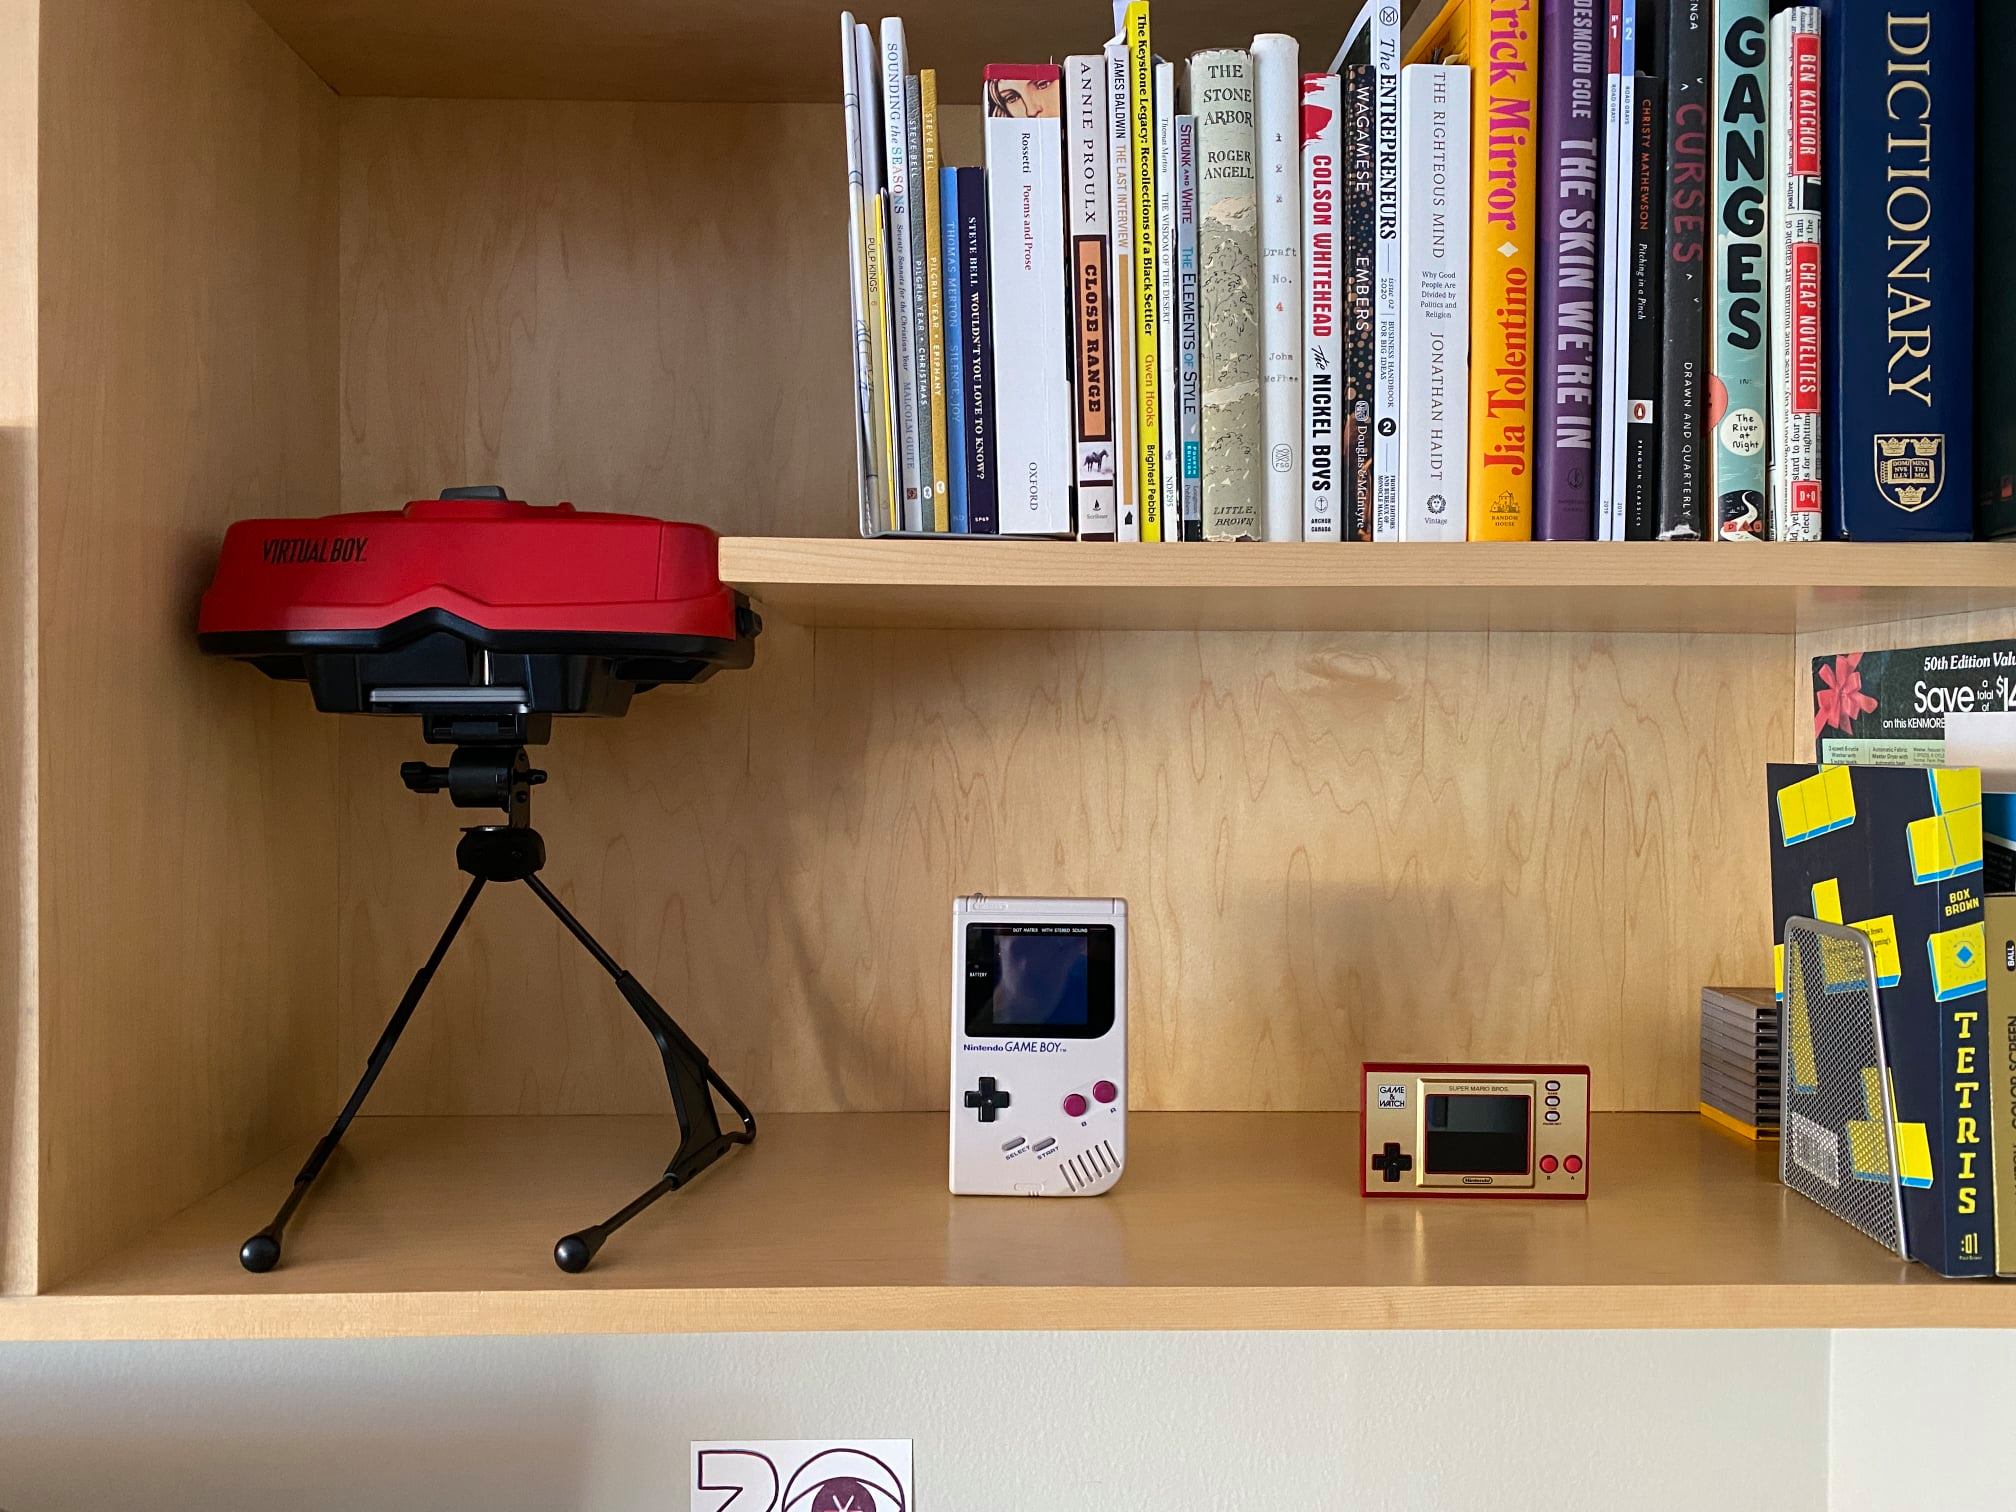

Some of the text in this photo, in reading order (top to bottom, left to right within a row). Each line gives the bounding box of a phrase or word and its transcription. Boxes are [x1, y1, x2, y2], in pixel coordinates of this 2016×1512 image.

[1208, 65, 1243, 79] THE
[1572, 0, 1592, 119] DESMOND COLE
[1800, 54, 1818, 81] BEN
[1113, 58, 1126, 139] JAMES BALDWIN
[1204, 88, 1252, 103] STONE
[1205, 111, 1254, 128] ARBOR
[1799, 90, 1817, 155] KATCHOR
[887, 43, 905, 214] SOUNDING the SEASONS
[909, 120, 918, 178] STEVE BELL
[925, 113, 934, 171] STEVE BELL
[1022, 133, 1032, 173] Rossetti
[1081, 62, 1096, 224] ANNIE PROULX
[1161, 118, 1170, 173] Thomas Merton
[1208, 150, 1252, 164] ROGER
[1356, 87, 1370, 192] WAGAMESE
[1379, 38, 1397, 240] The ENTREPRENEURS
[1137, 14, 1154, 336] The Keystone Legacy: Recollections of a Black Settler
[1180, 124, 1192, 224] STRUNK WHITE
[1204, 166, 1254, 180] ANGELL
[1432, 72, 1446, 258] THE RIGHTEOUS MIND
[1488, 95, 1531, 230] Mirror
[1639, 99, 1651, 231] CHRISTY MATHEWSON
[1672, 103, 1707, 263] CURSES
[1723, 16, 1767, 350] GANGES
[1116, 145, 1129, 248] THE LAST INTERVIEW
[1887, 10, 1931, 408] DICTIONARY
[968, 216, 979, 287] STEVE BELL
[1022, 185, 1034, 271] Poems and Prose
[1264, 248, 1297, 258] Draft
[1313, 155, 1332, 337] COLSON WHITEHEAD
[868, 237, 878, 292] PULP KINGS
[946, 221, 958, 327] THOMAS MERTON
[1161, 193, 1171, 324] THE WISDOM OF THE DESERT
[1272, 275, 1292, 284] No.
[1421, 281, 1443, 289] People
[1636, 243, 1648, 320] Pitching Pinch
[914, 261, 924, 331] PILGRIM YEAR
[930, 257, 940, 328] PILGRIM YEAR
[1275, 302, 1284, 312] 4
[1355, 257, 1369, 330] EMBERS
[1421, 290, 1446, 299] Divided
[1556, 137, 1597, 450] THE SKIN WE'RE IN
[900, 315, 909, 352] Christian
[1084, 264, 1101, 412] CLOSE RANGE
[1182, 247, 1198, 415] THE ELEMENTS OF STYLE
[1268, 352, 1293, 361] John
[1380, 321, 1388, 380] FOR BIG IDEAS
[1799, 263, 1817, 393] CHEAP NOVELTIES
[919, 348, 928, 405] CHRISTMAS
[932, 344, 942, 396] EPIPHANY
[970, 292, 985, 479] WOULDN'T YOU LOVE TO KNOW?
[1145, 355, 1157, 427] Gwen Hooks
[1387, 321, 1395, 408] BUSINESS HANDBOOK
[1484, 267, 1528, 476] Jia Tolentino
[903, 382, 914, 434] MALCOLM
[1311, 345, 1332, 491] The NICKEL BOYS
[1430, 332, 1444, 481] JONATHAN HAIDT
[1732, 423, 1758, 432] River
[1736, 414, 1754, 422] The
[1682, 362, 1693, 516] DRAWN AND QUARTERLY
[1732, 441, 1759, 452] Night
[1028, 461, 1039, 511] OXFORD
[1145, 444, 1157, 523] Brightest Pebble
[1354, 425, 1368, 528] Douglas McIntyre
[1213, 506, 1256, 515] LITTLE,
[1214, 518, 1254, 527] BROWN
[263, 537, 368, 564] VIRTUAL BOY
[1923, 653, 1990, 671] 50th Edition
[1982, 679, 1989, 688] a
[1883, 717, 1946, 729] on this KENMORE
[1913, 680, 1994, 713] Save total
[1981, 701, 1990, 712] of
[1945, 897, 1980, 917] BROWN
[1949, 888, 1970, 904] BOX
[963, 1041, 1062, 1053] Nintendo GAME BOY
[1379, 1086, 1405, 1094] GAME
[1954, 1012, 1980, 1214] TETRIS
[1005, 1145, 1030, 1160] SELECT
[1037, 1146, 1060, 1160] START
